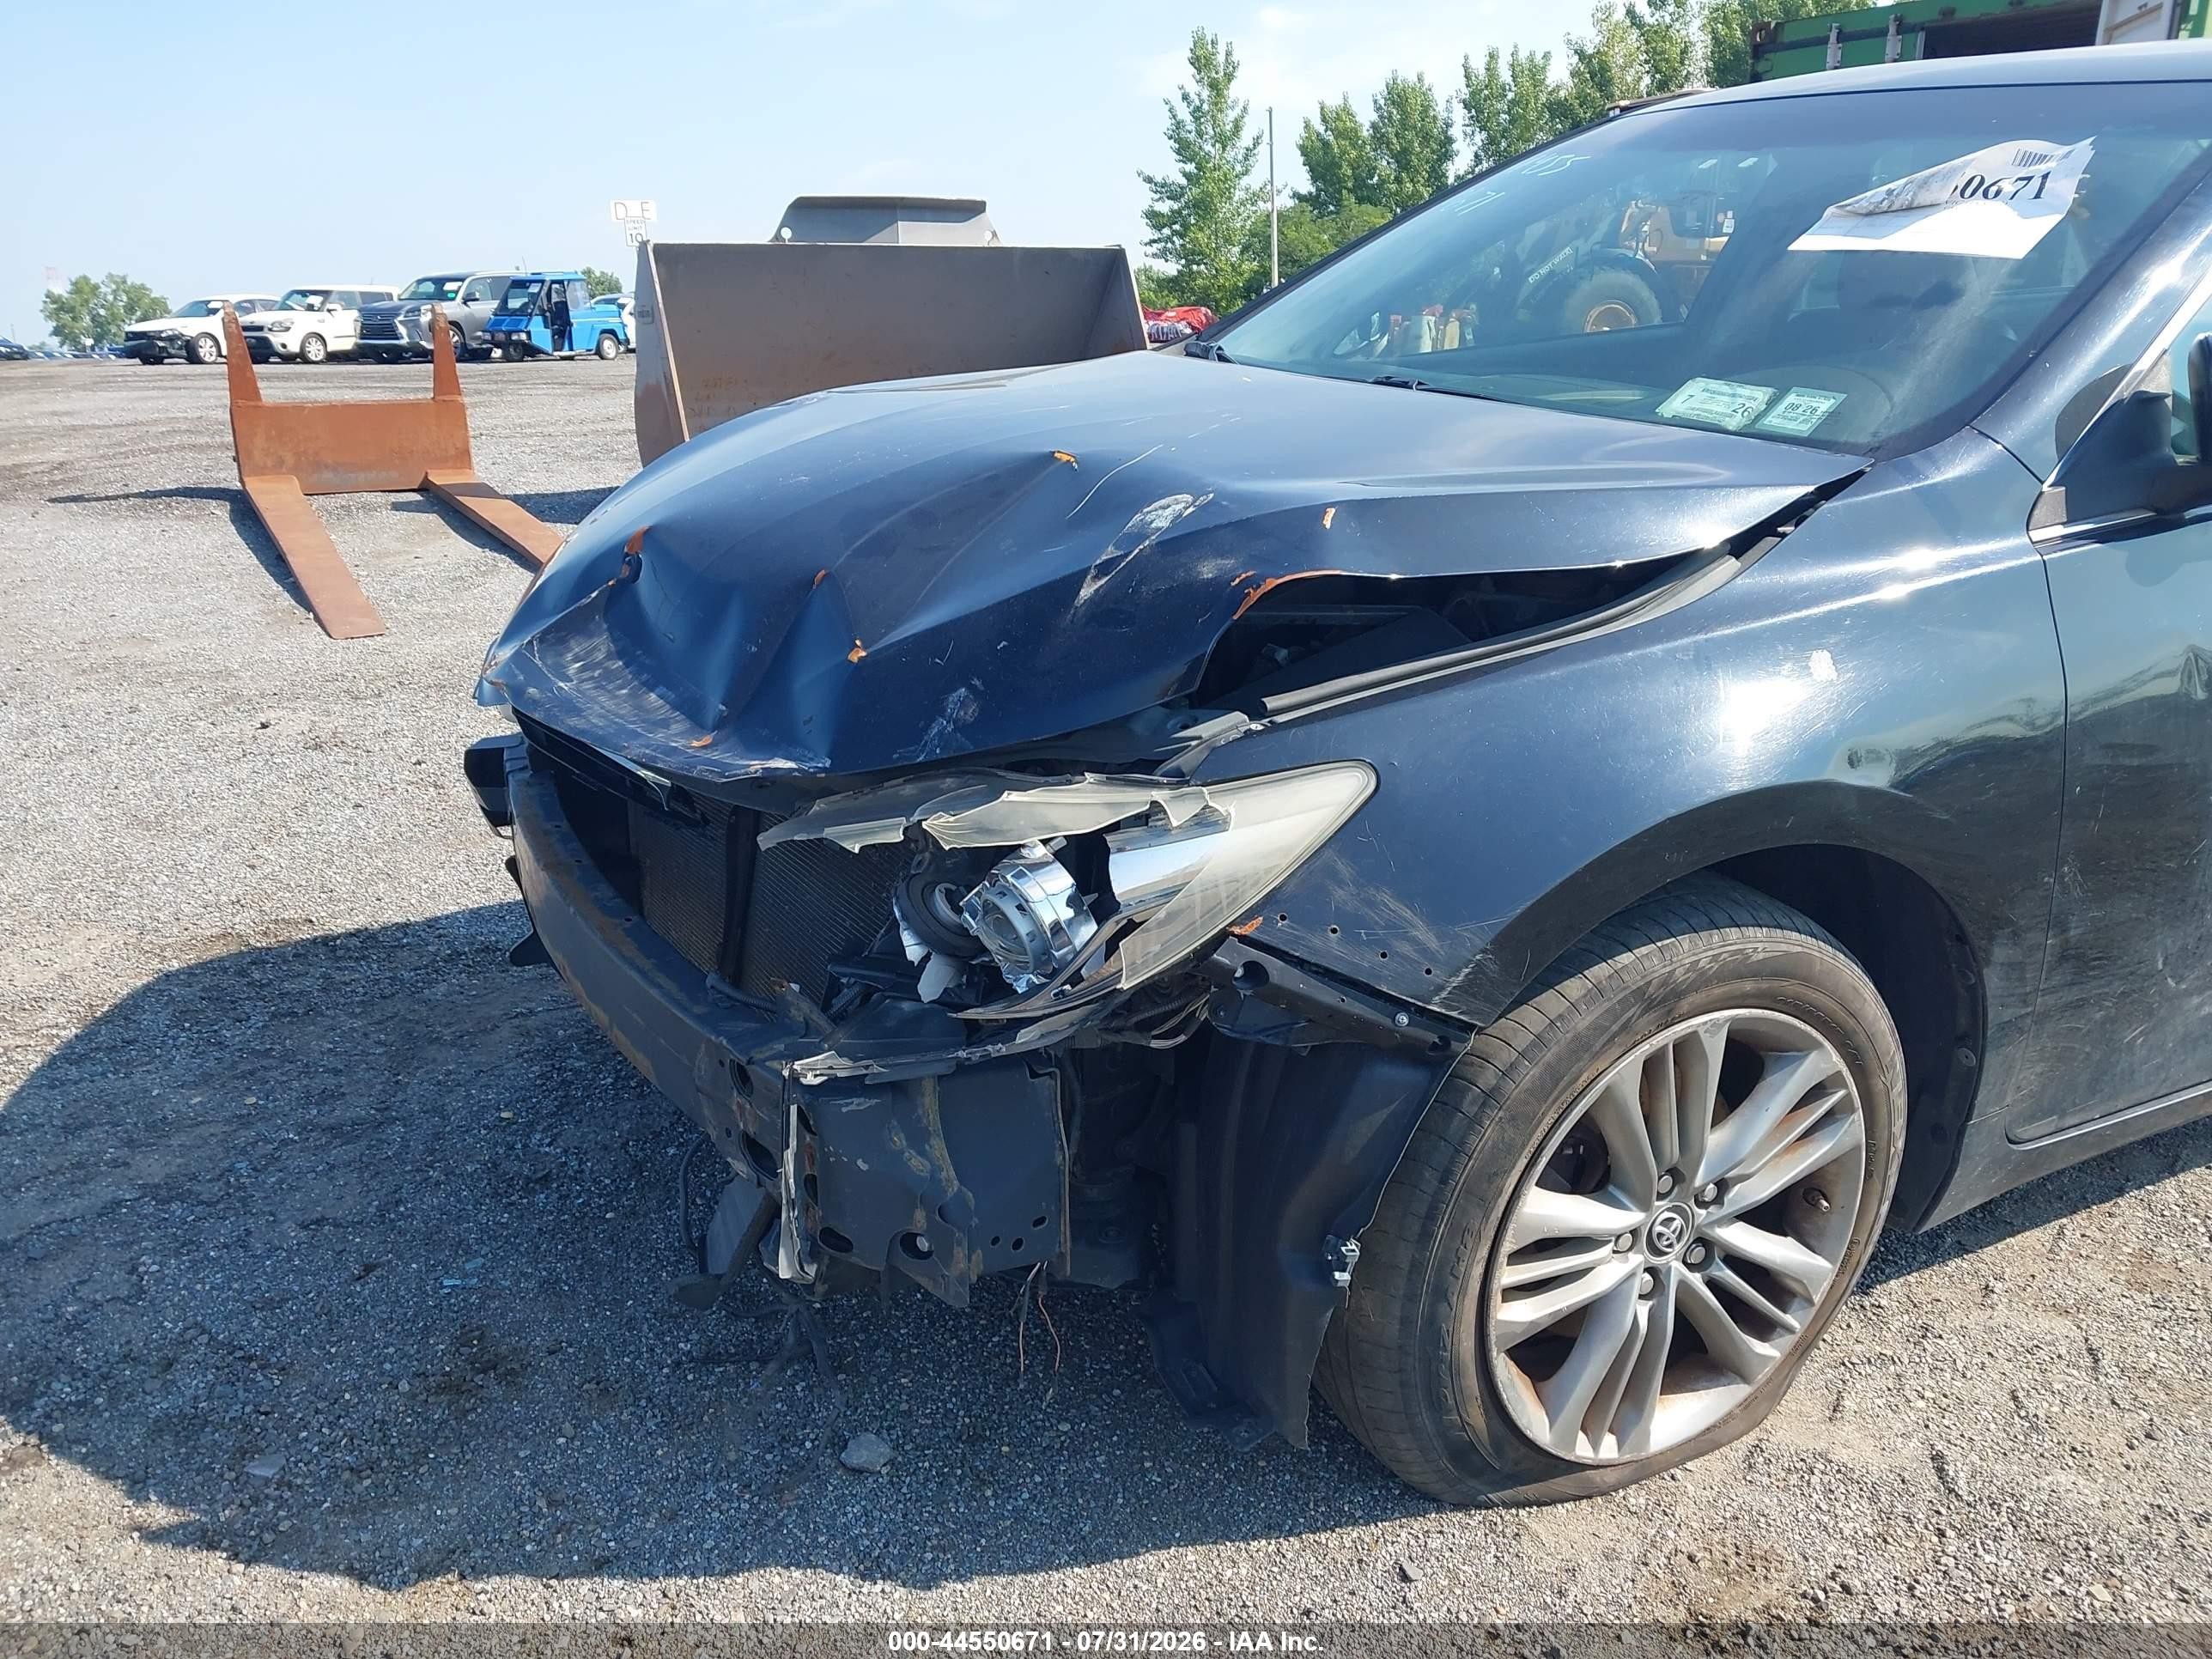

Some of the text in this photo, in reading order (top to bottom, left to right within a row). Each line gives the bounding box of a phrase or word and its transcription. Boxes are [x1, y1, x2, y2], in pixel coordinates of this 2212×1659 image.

[1950, 171, 2051, 201] 0671
[614, 202, 652, 220] D E
[629, 233, 644, 244] 10
[1731, 403, 1753, 419] 26
[1784, 402, 1821, 415] 08 26
